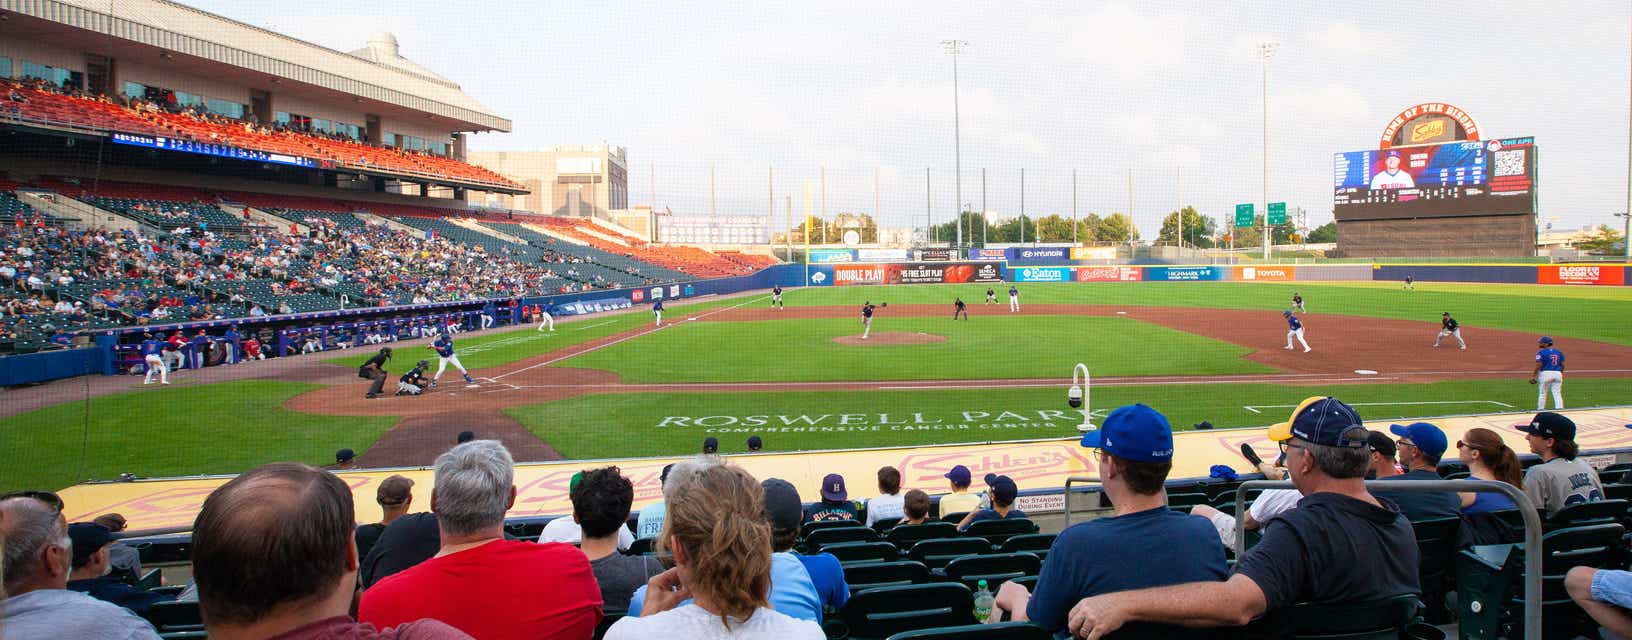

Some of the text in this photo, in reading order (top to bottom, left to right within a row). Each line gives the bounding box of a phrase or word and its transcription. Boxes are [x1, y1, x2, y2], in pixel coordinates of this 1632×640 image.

[1383, 104, 1476, 141] HOME OF THE BISONS
[836, 269, 886, 282] DOUBLE PLAY!
[1032, 268, 1062, 278] Eaton
[1550, 354, 1558, 366] 7
[656, 408, 1108, 426] ROSWELL PARK
[706, 425, 880, 433] COMPREHENSIVE
[833, 483, 841, 492] H
